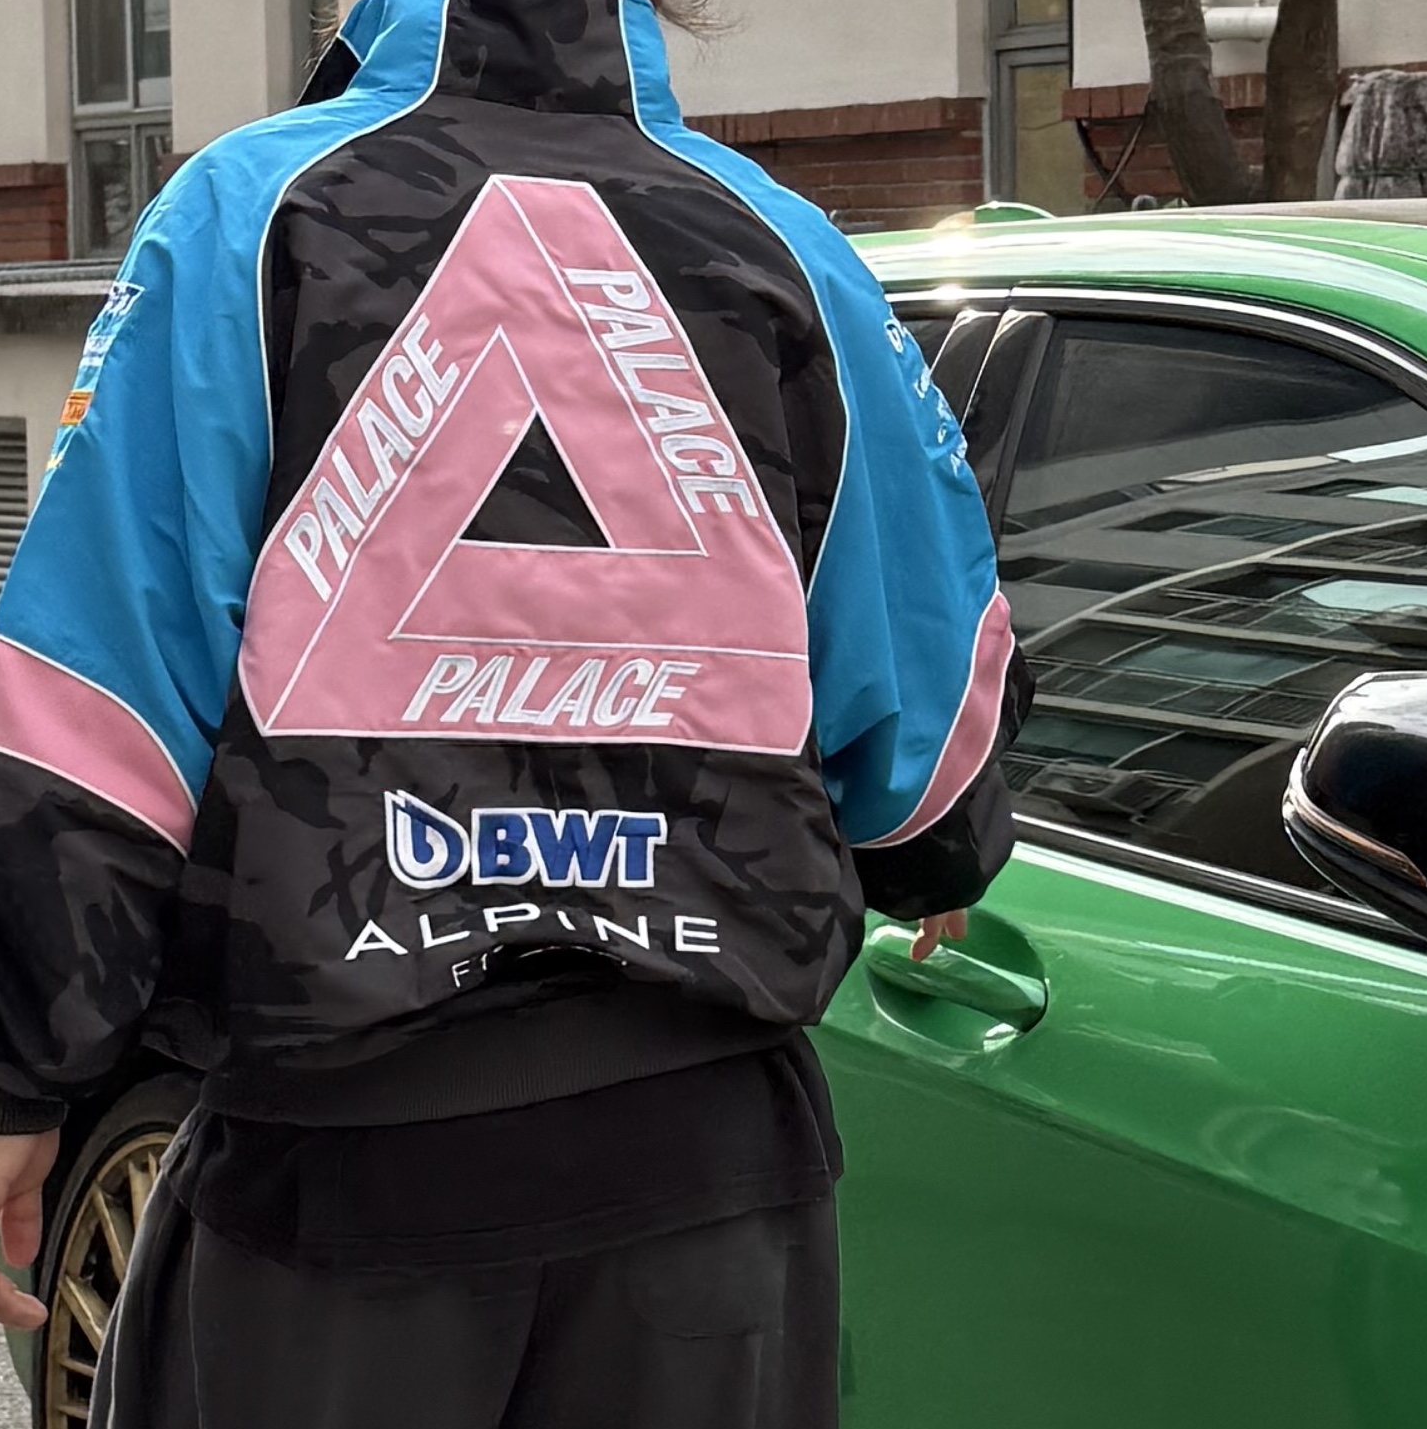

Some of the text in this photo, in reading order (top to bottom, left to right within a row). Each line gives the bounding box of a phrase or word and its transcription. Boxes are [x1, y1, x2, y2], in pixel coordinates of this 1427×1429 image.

[566, 268, 760, 517] PALACE
[283, 313, 460, 602] PALACE
[402, 654, 702, 727] PALACE
[472, 807, 668, 888] BWT
[344, 903, 721, 961] ALPINE
